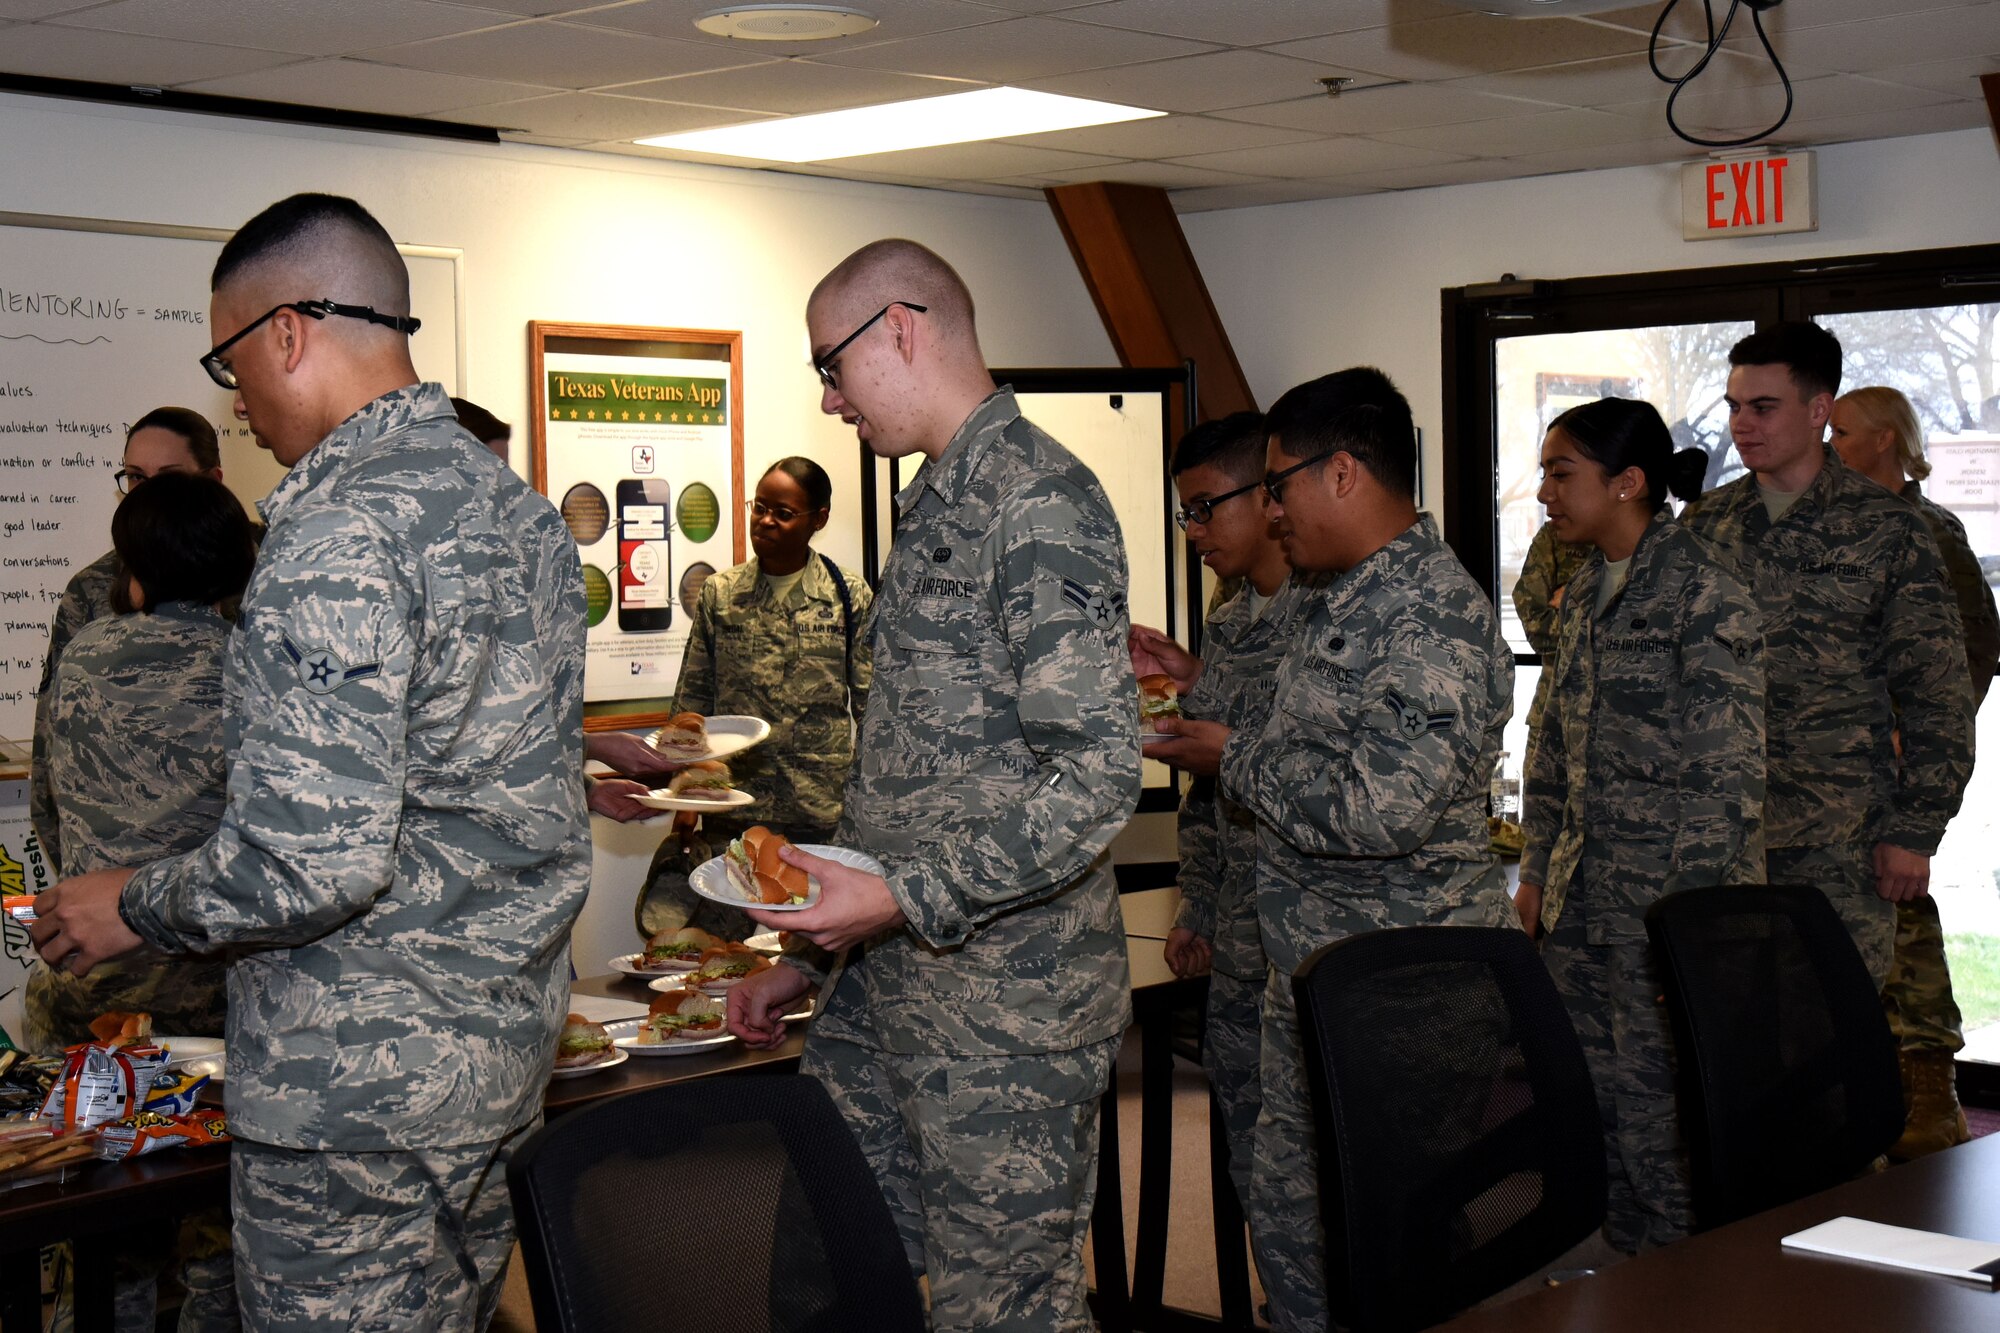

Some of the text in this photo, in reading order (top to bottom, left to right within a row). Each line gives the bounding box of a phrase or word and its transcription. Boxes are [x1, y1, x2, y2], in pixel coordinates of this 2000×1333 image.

[1706, 158, 1788, 229] EXIT
[154, 308, 204, 324] SAMPLE
[555, 376, 721, 408] Texas Veterans App
[42, 459, 52, 468] or
[61, 451, 95, 468] conflict
[102, 457, 113, 468] in
[30, 494, 39, 504] in
[49, 495, 79, 504] career.
[4, 520, 24, 537] good
[1836, 563, 1873, 579] FORCE
[935, 578, 972, 598] FORCE
[4, 620, 49, 638] planning
[812, 624, 825, 633] AIR
[1620, 638, 1634, 652] AIR
[1634, 639, 1673, 653] FORCE
[1313, 657, 1326, 675] AIR
[1321, 661, 1354, 684] FORCE
